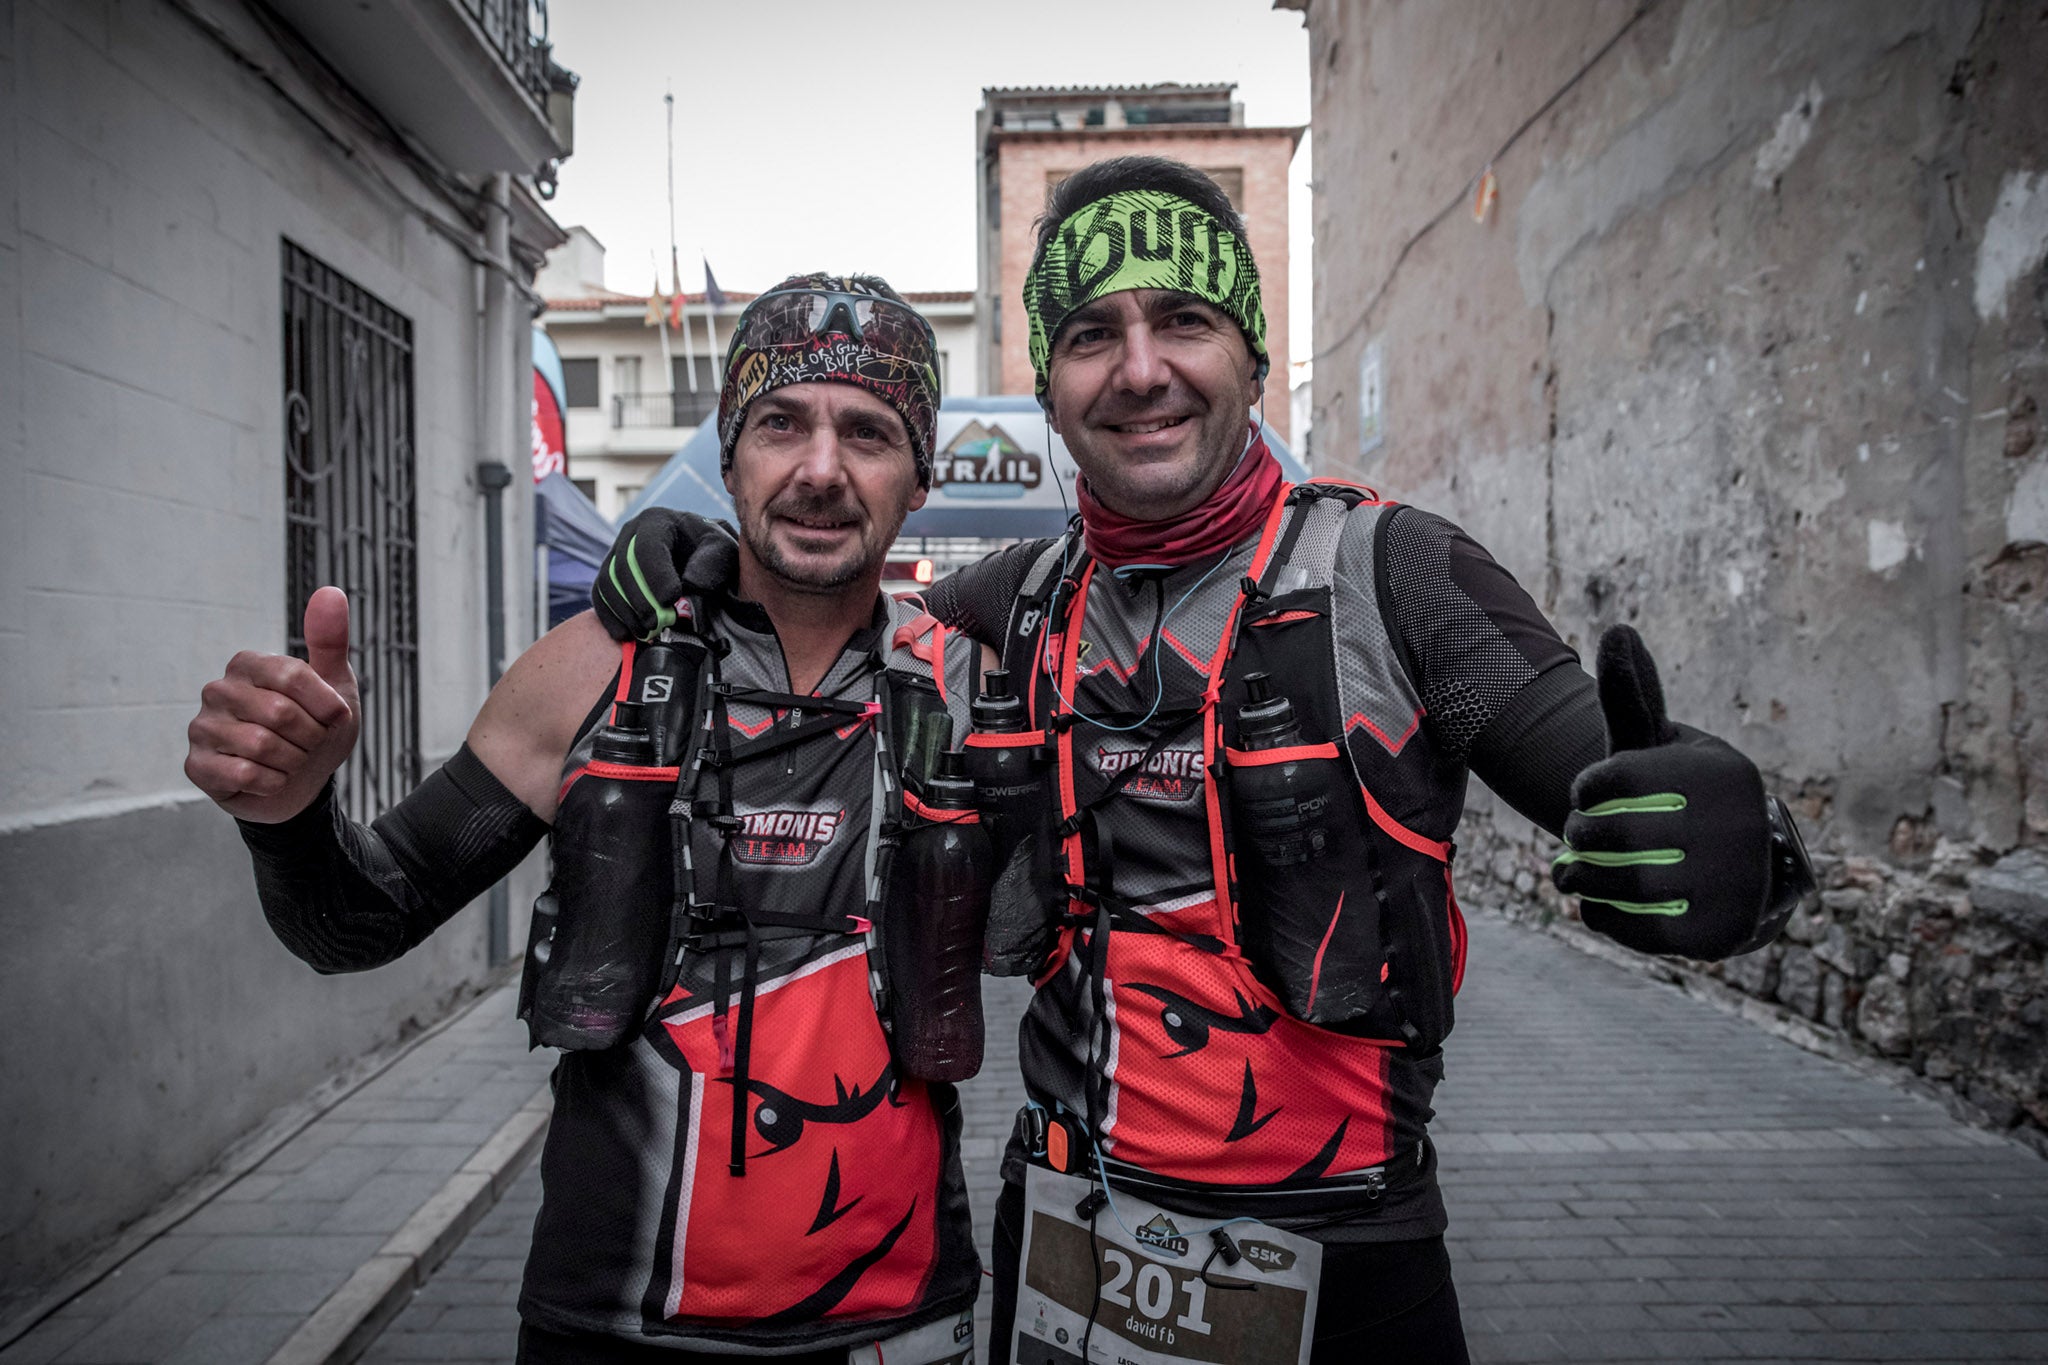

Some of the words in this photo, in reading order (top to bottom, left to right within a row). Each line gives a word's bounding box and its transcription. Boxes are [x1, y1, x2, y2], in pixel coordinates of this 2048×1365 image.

[933, 459, 1038, 483] TRAIL
[735, 813, 838, 842] IMONIS
[745, 840, 806, 857] TEAM
[1249, 1246, 1283, 1266] 55K
[1101, 1249, 1212, 1336] 201
[1125, 1315, 1156, 1339] david
[1159, 1326, 1167, 1342] f
[1167, 1328, 1176, 1345] b
